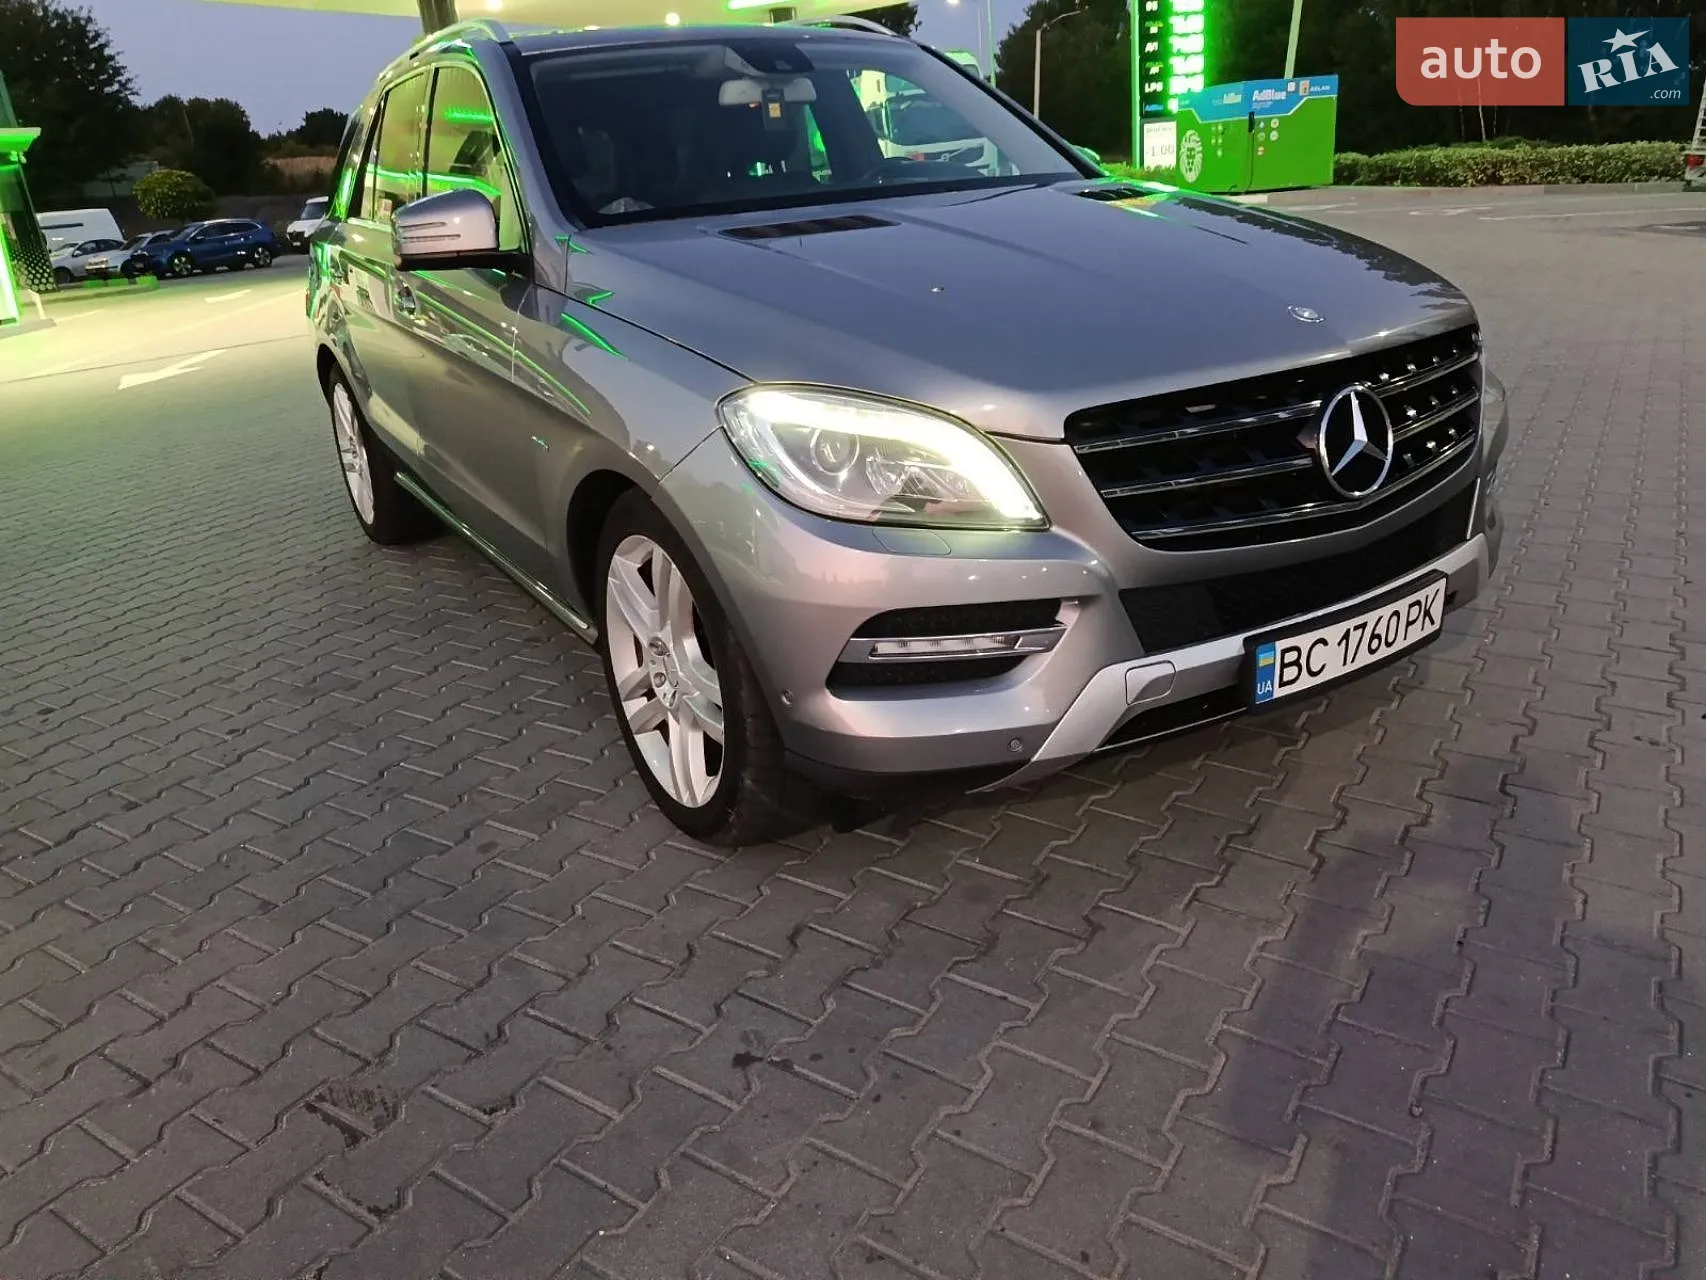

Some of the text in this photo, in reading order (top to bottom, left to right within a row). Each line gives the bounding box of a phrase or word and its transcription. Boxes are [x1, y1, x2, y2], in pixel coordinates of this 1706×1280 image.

[1253, 88, 1286, 101] AdBlue
[1278, 588, 1440, 689] BC 1760 PK
[1256, 680, 1273, 695] UA
